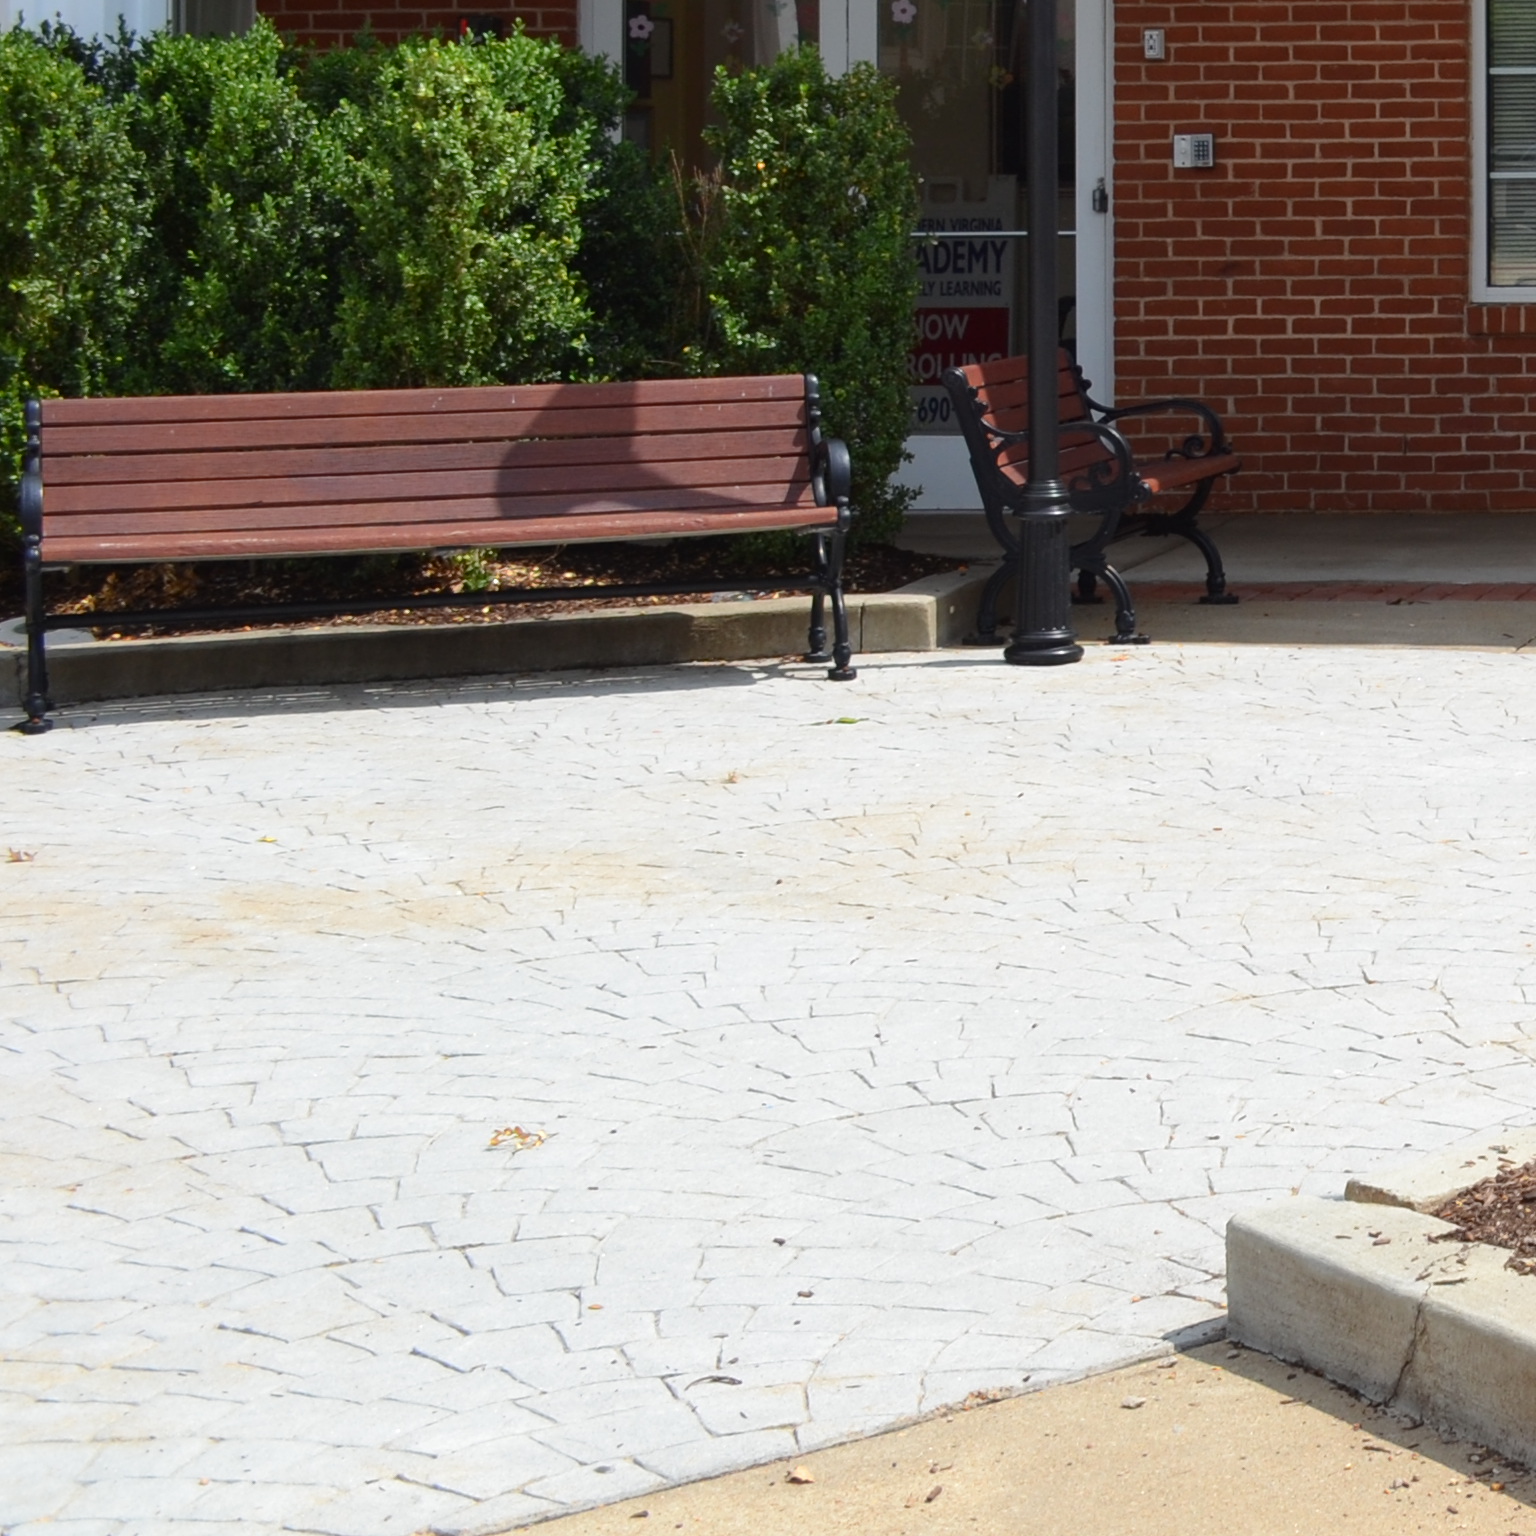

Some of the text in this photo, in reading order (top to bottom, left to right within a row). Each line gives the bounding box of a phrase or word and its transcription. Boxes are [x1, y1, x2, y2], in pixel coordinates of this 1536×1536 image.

[949, 216, 1003, 232] VIRGINIA
[915, 240, 1008, 274] ADEMY
[940, 280, 1002, 297] LEARNING
